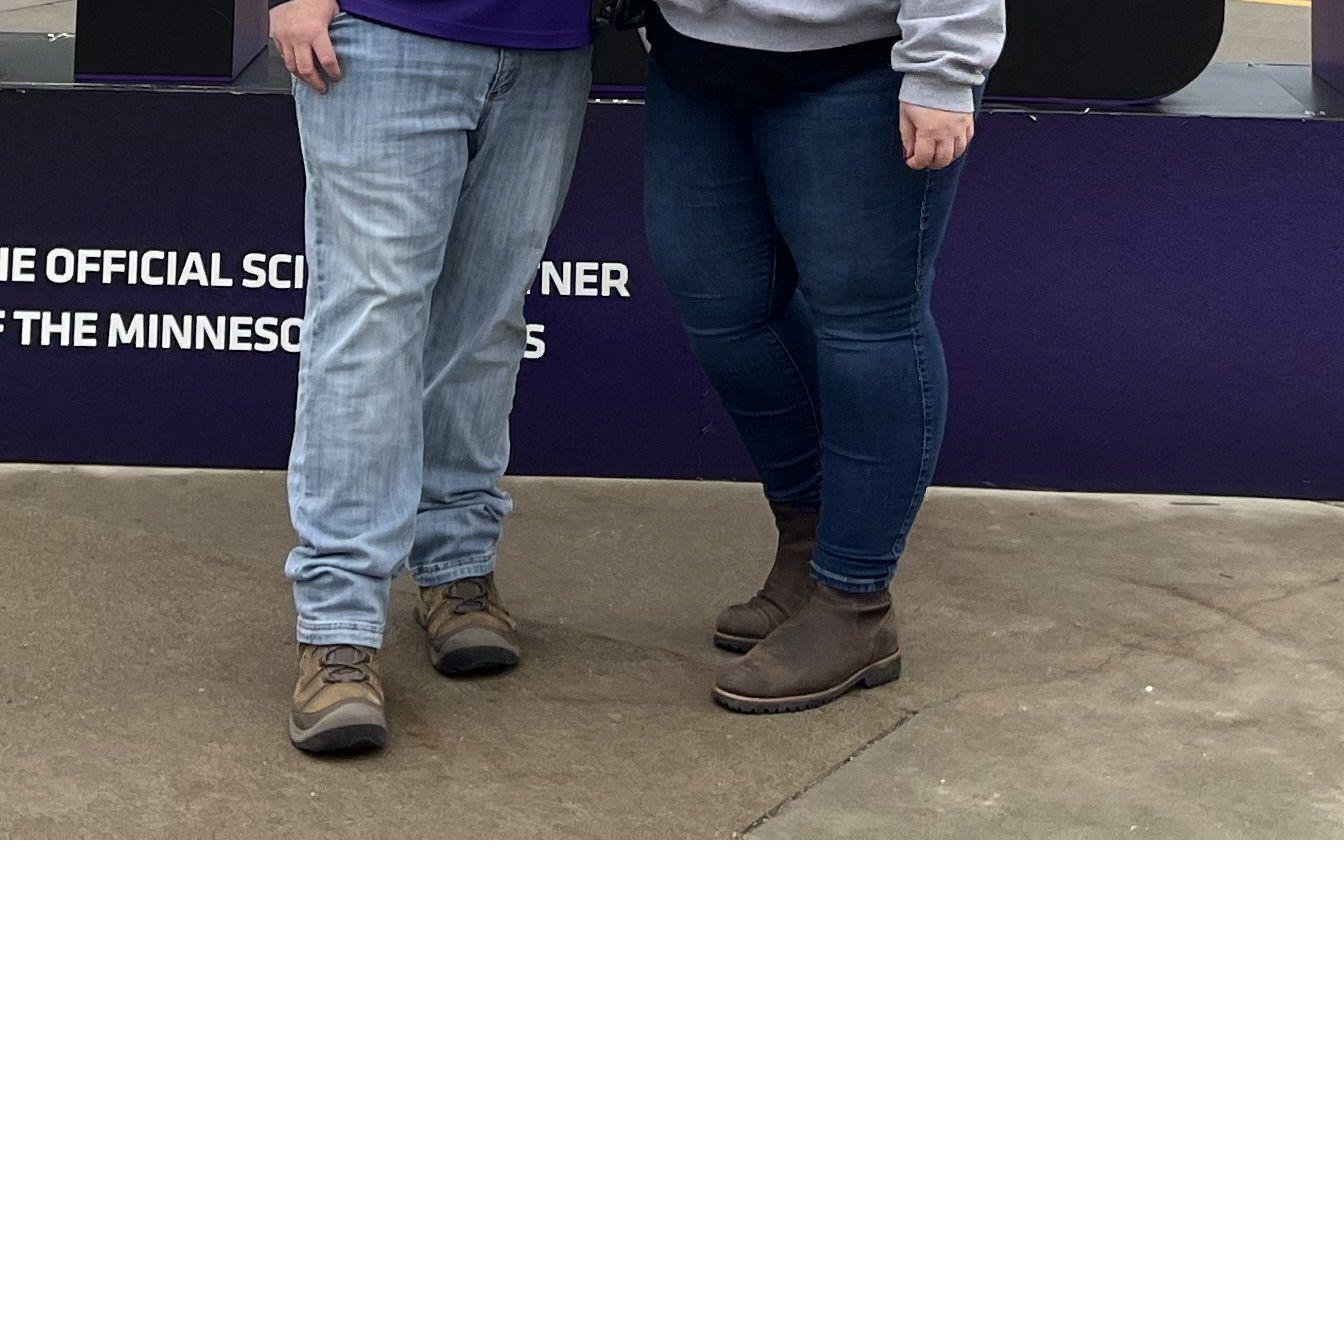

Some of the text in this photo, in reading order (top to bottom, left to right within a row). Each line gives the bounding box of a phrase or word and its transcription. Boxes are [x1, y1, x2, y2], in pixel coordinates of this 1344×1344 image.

[46, 248, 233, 288] OFFICIAL
[242, 253, 305, 289] SCI
[527, 259, 631, 298] NER
[13, 310, 97, 347] THE
[108, 314, 304, 353] MINNESO
[523, 324, 545, 359] S
